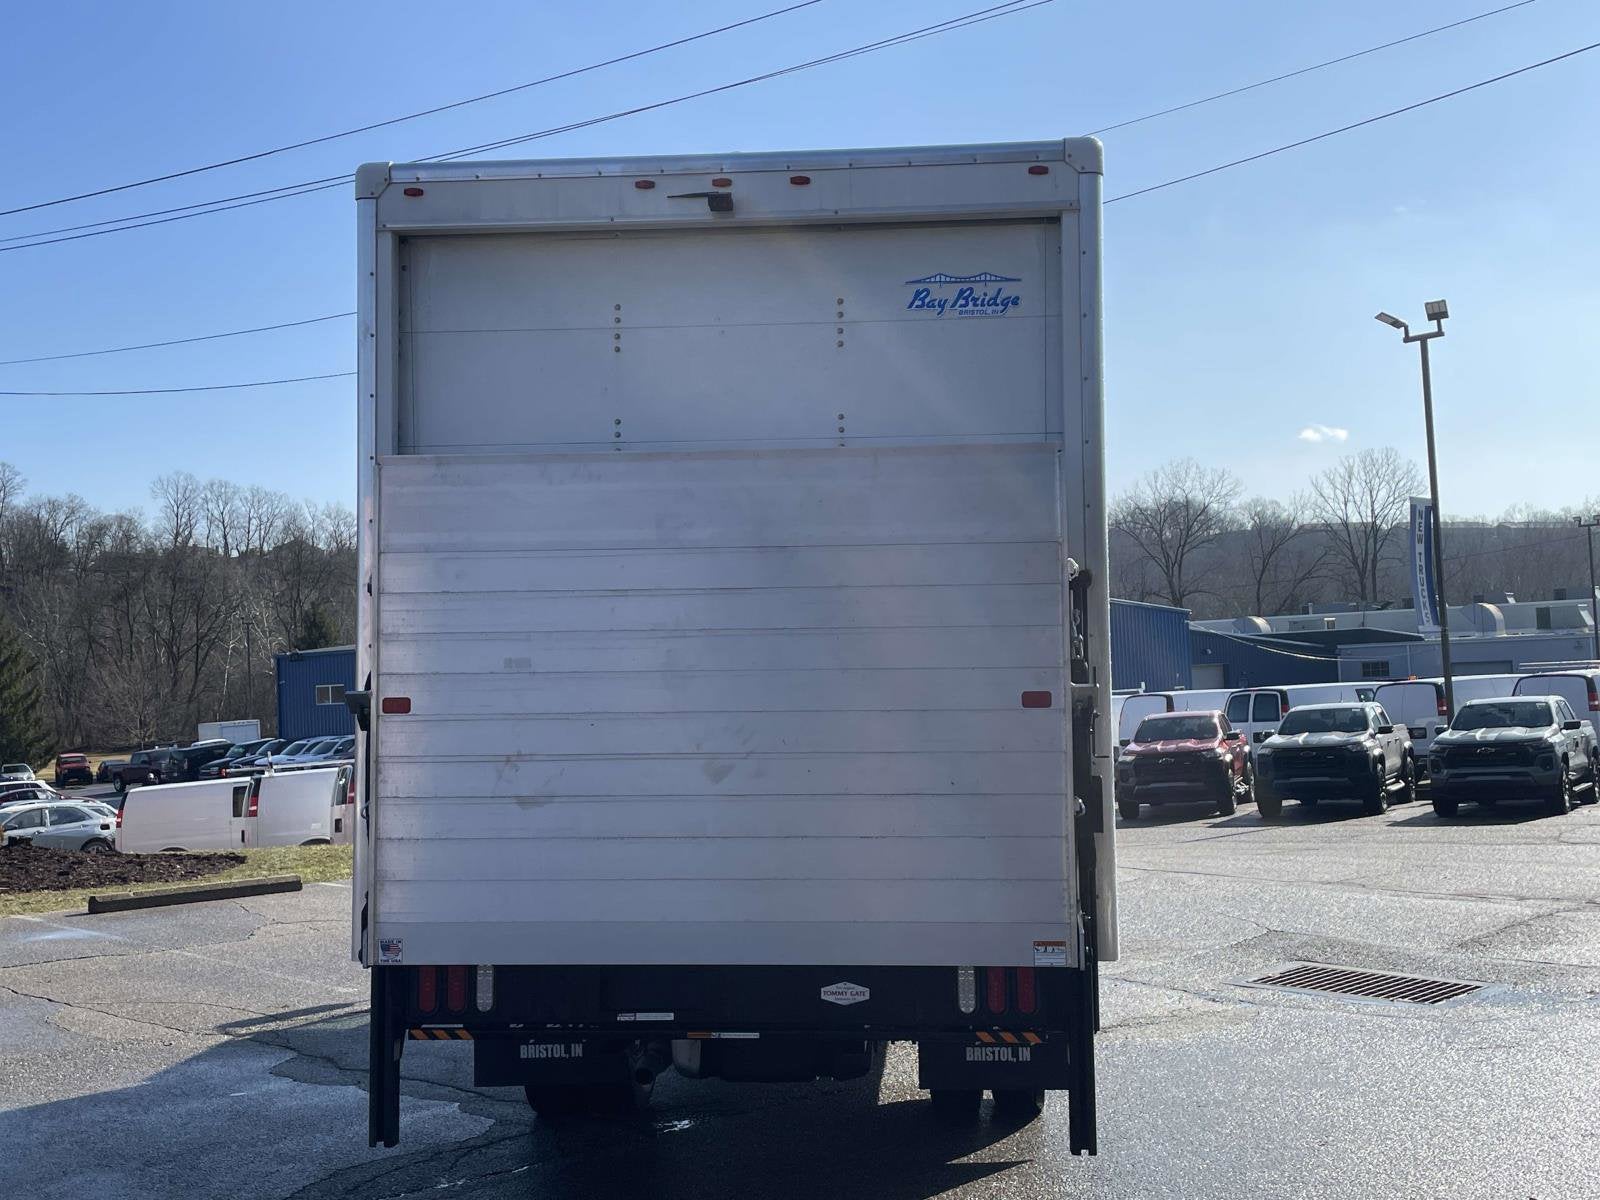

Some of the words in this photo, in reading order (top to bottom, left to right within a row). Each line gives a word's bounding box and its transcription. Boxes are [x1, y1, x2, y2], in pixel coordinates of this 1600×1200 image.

[907, 287, 949, 316] Bay
[950, 286, 1020, 314] Bridge
[1416, 509, 1424, 545] NEW
[1418, 552, 1430, 622] TRUCKS
[520, 1043, 569, 1059] BRISTOL,
[571, 1043, 583, 1058] IN
[965, 1046, 1016, 1062] BRISTOL,
[1018, 1046, 1031, 1062] IN
